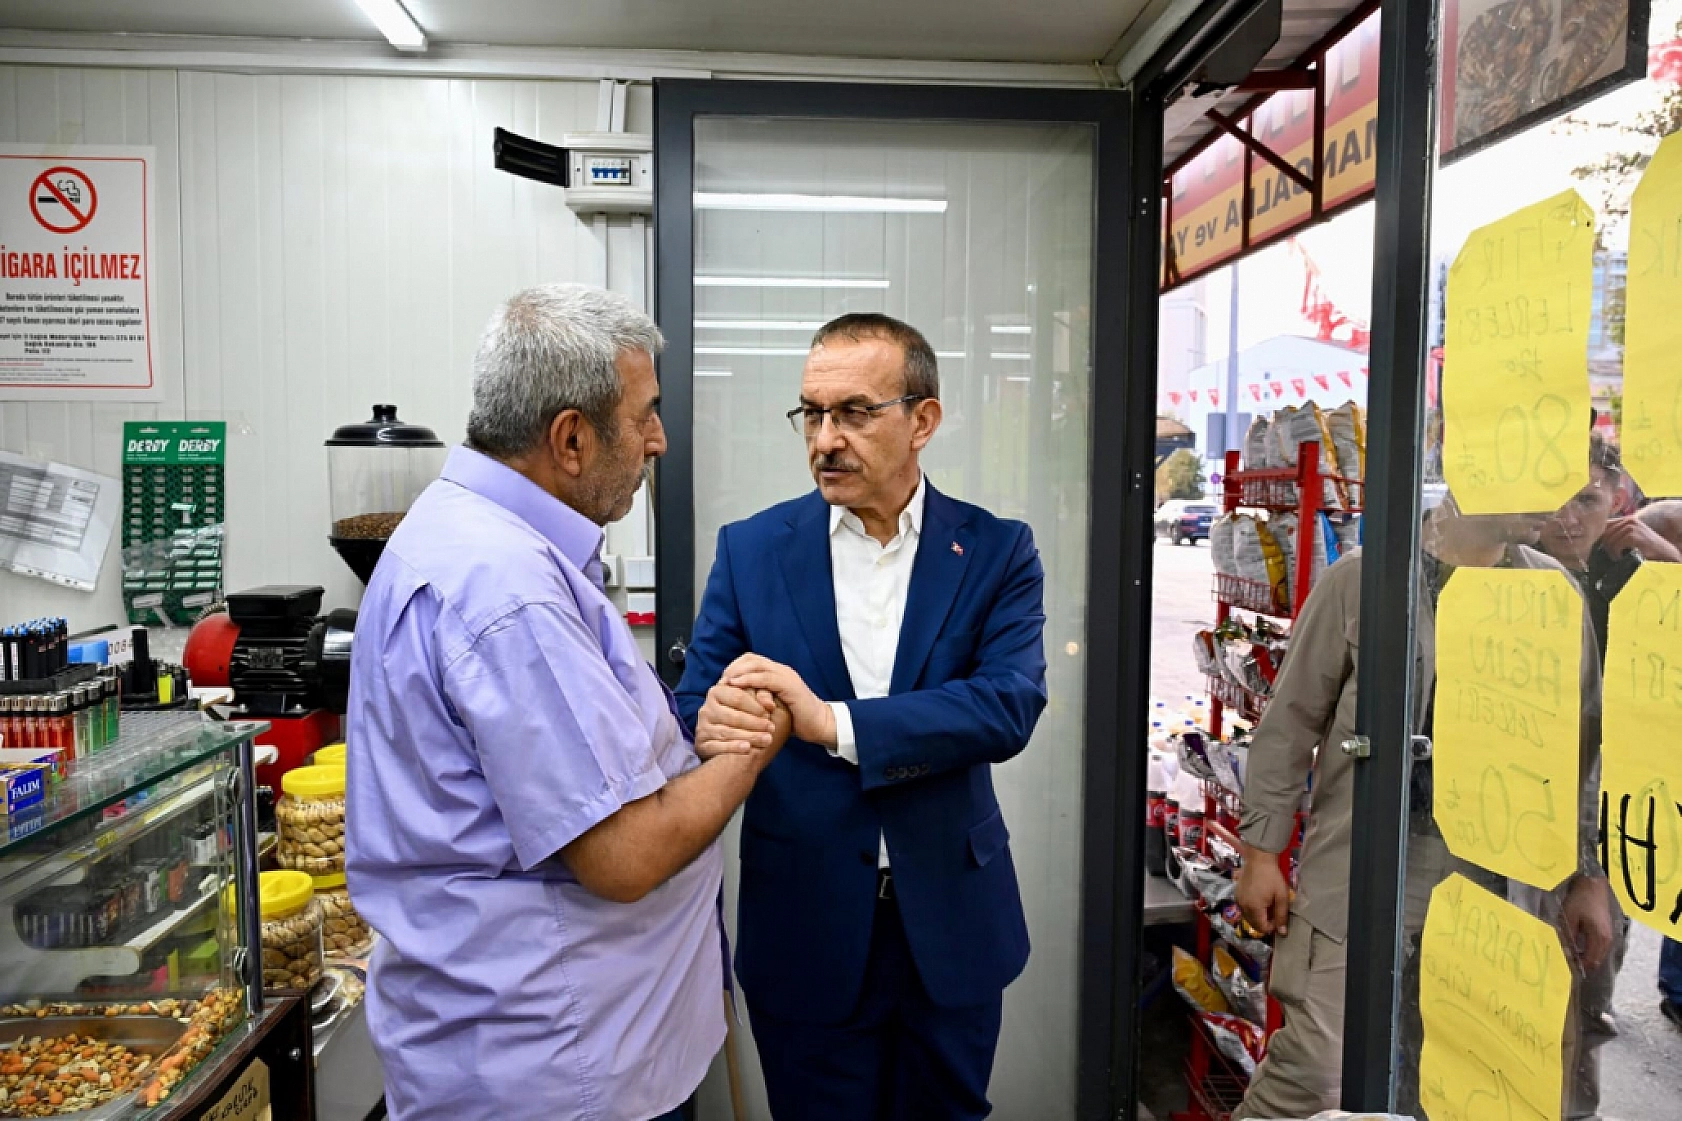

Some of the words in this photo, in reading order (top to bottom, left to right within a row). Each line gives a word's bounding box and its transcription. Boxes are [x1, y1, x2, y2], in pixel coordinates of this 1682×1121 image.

[63, 244, 141, 287] İÇİLMEZ
[126, 438, 171, 452] DERBY
[177, 438, 222, 452] DERBY
[12, 778, 40, 800] FALIM
